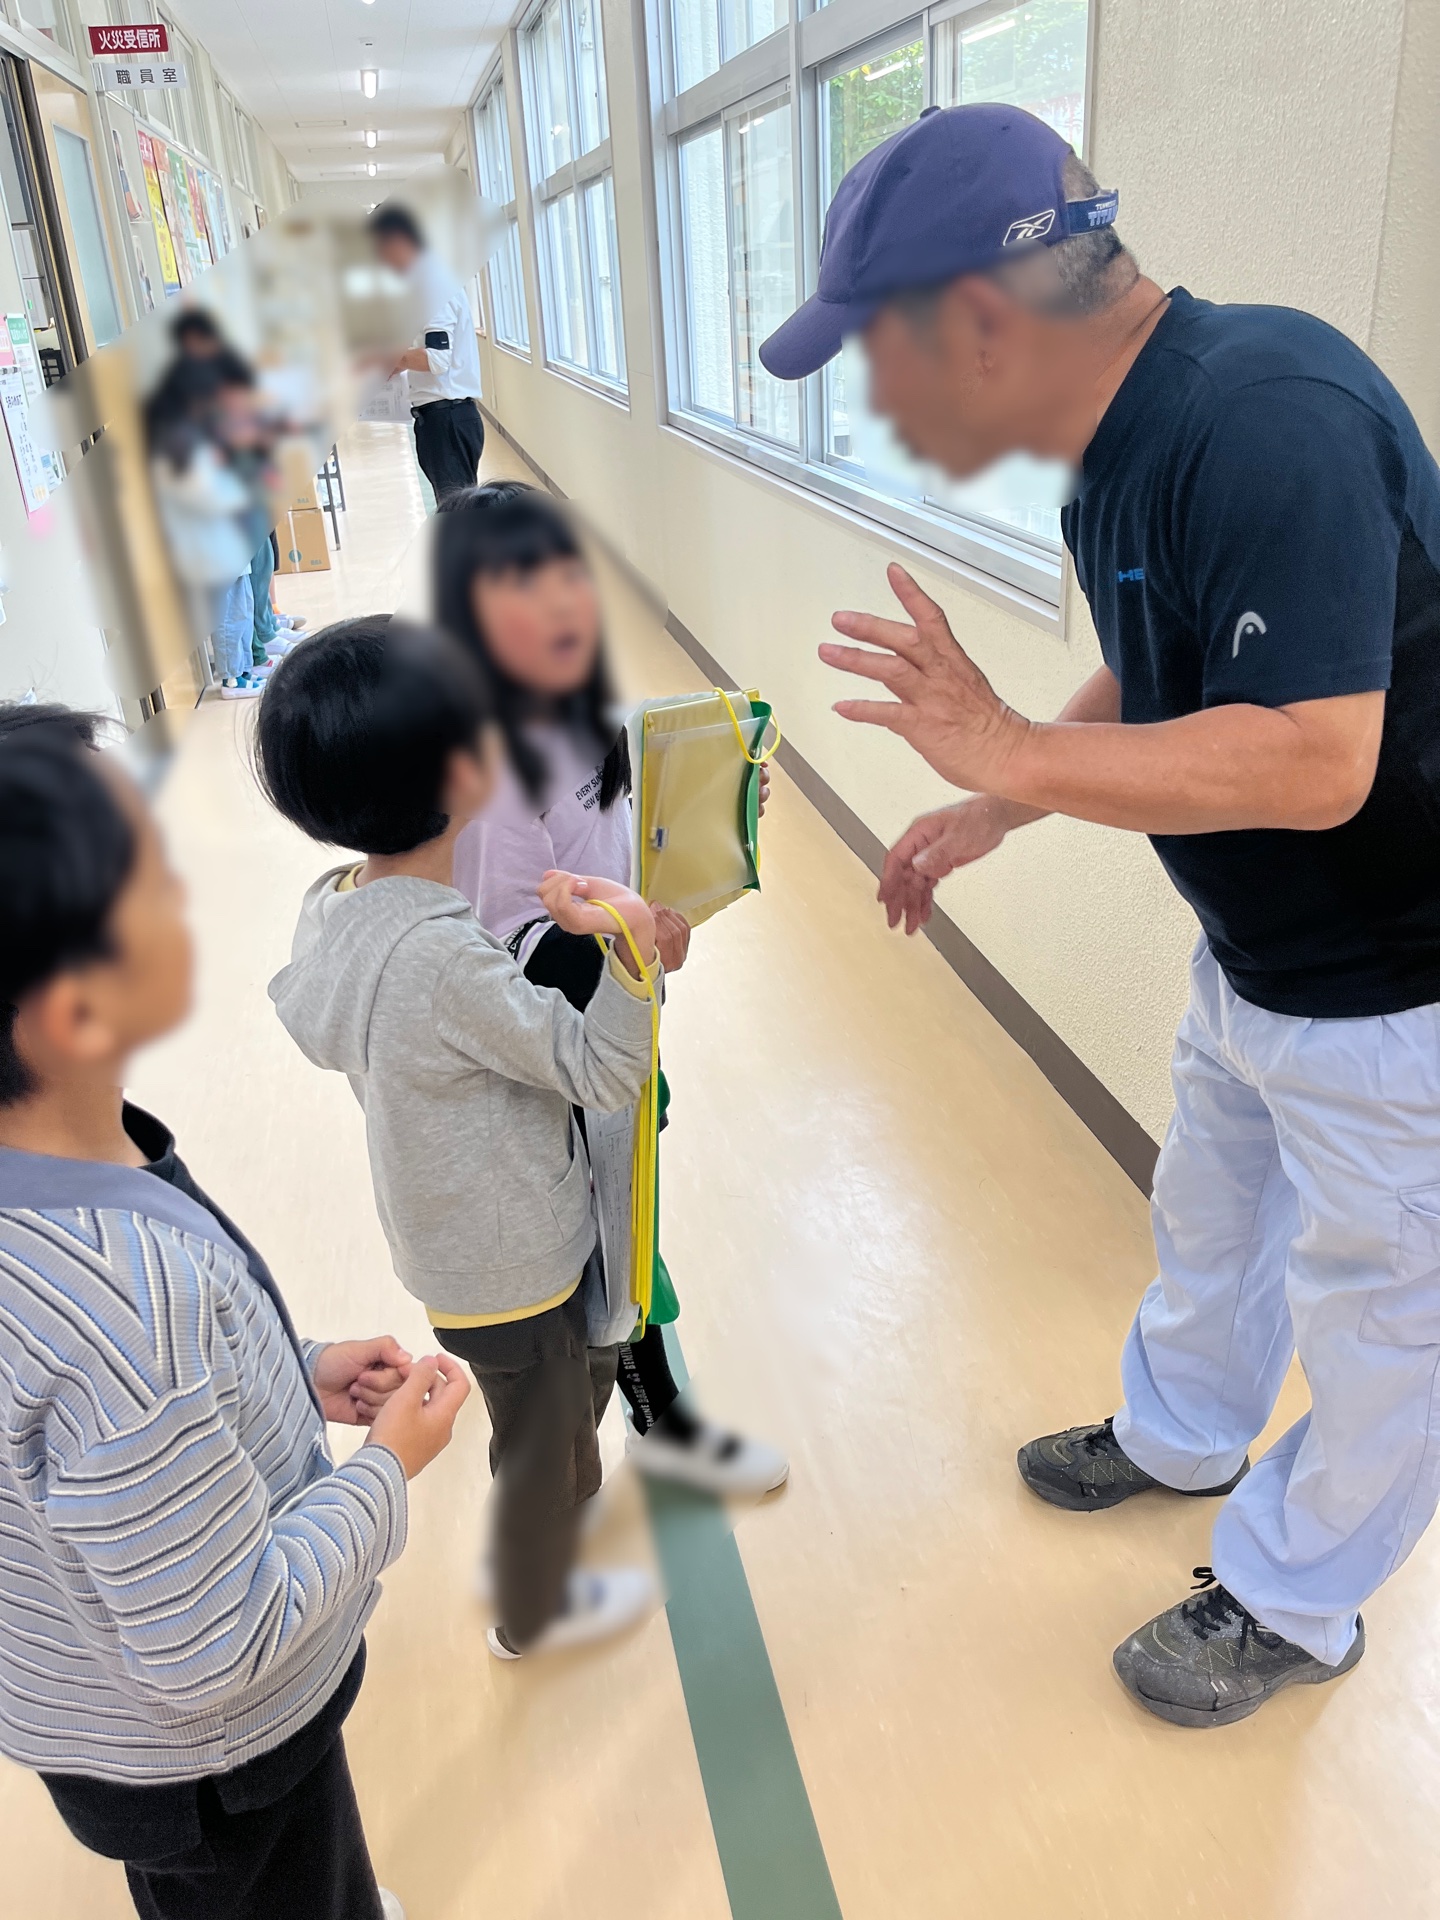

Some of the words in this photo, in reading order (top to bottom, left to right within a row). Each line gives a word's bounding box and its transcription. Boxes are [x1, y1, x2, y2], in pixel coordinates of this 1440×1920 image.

[97, 29, 161, 50] 火災受信所
[116, 68, 178, 85] 職員室
[575, 781, 593, 801] EVERY
[582, 795, 596, 812] NEW
